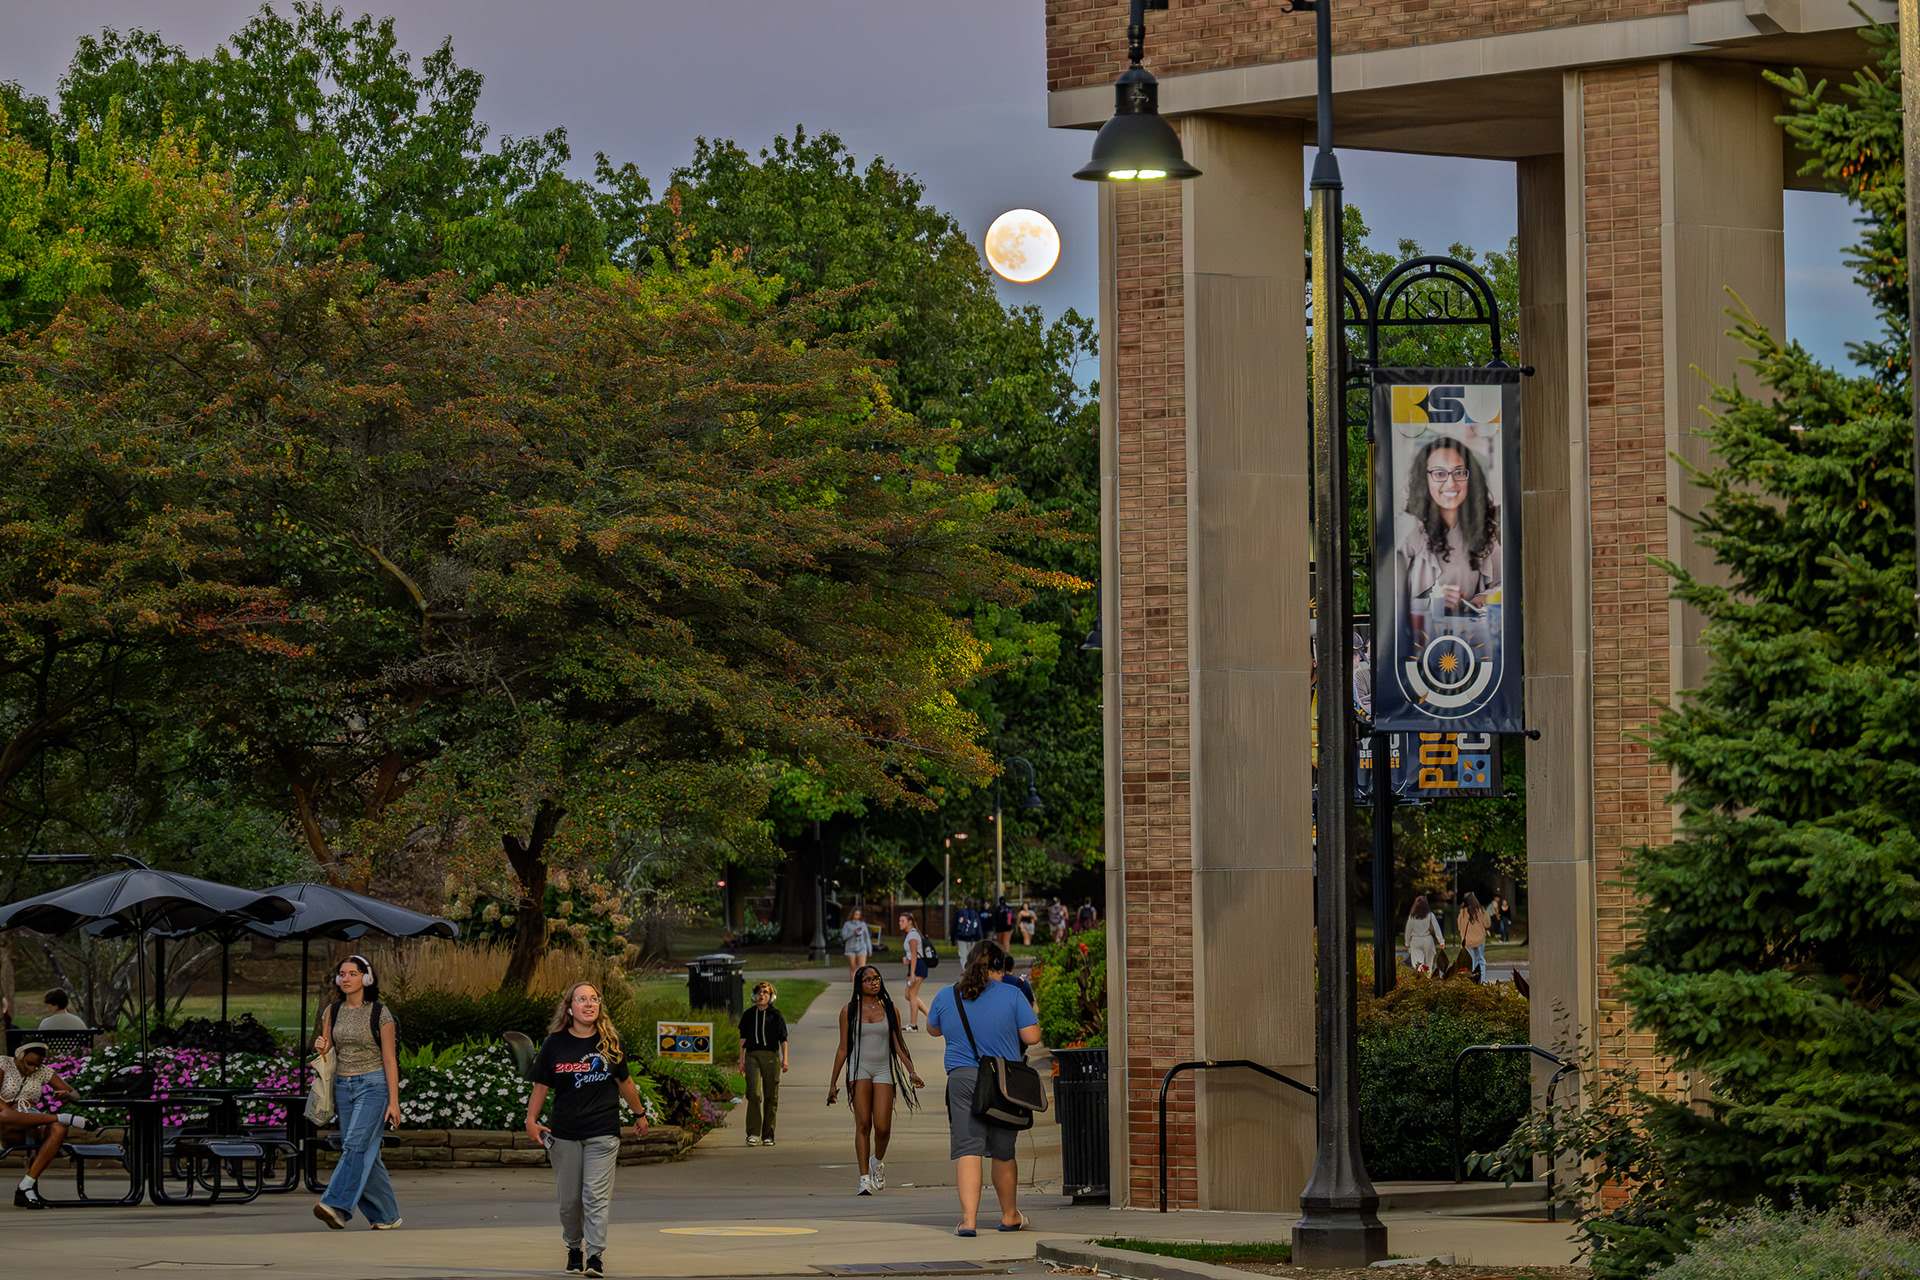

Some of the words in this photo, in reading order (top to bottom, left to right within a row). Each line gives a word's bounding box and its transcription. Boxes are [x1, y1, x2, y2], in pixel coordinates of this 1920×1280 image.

[1404, 291, 1465, 319] KSU
[1393, 386, 1500, 423] KSU
[1360, 734, 1399, 749] YU
[555, 1062, 590, 1073] 2025
[574, 1071, 611, 1089] Senior
